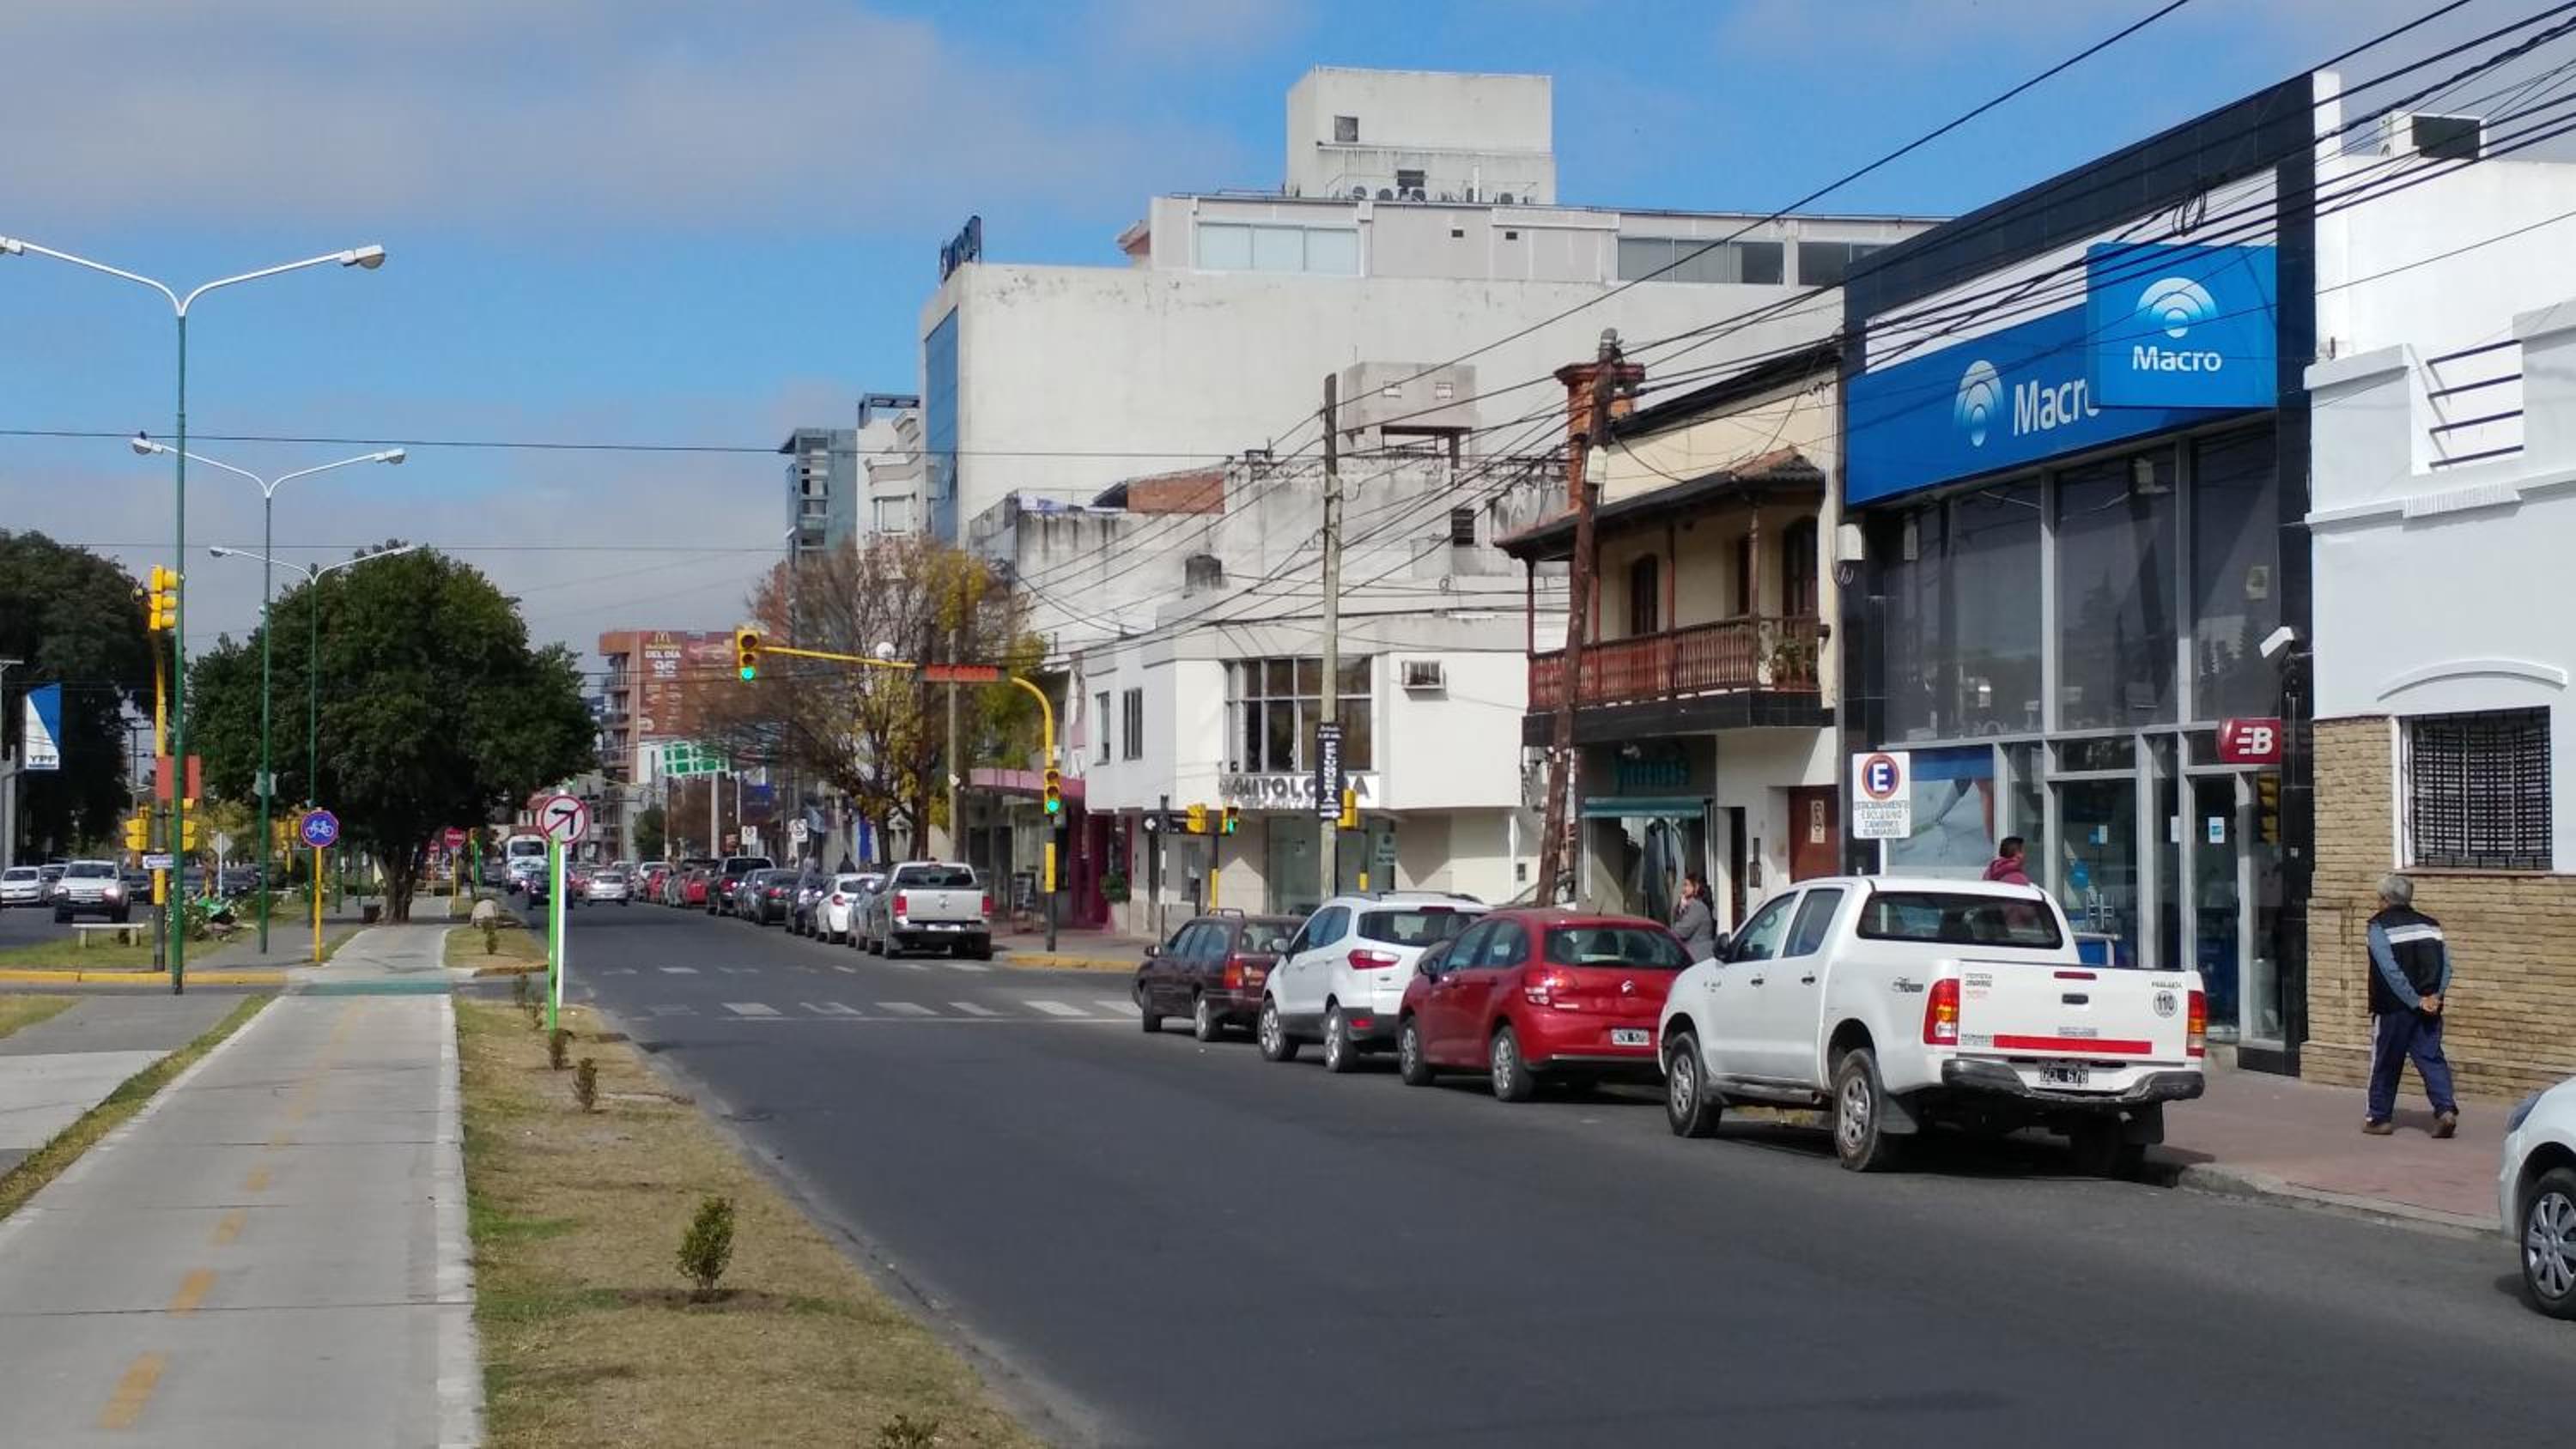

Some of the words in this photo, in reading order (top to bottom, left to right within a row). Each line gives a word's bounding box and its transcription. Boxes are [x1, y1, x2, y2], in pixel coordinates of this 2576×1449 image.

[2132, 345, 2222, 372] Macro
[1873, 763, 1889, 791] E
[2157, 995, 2174, 1011] 110
